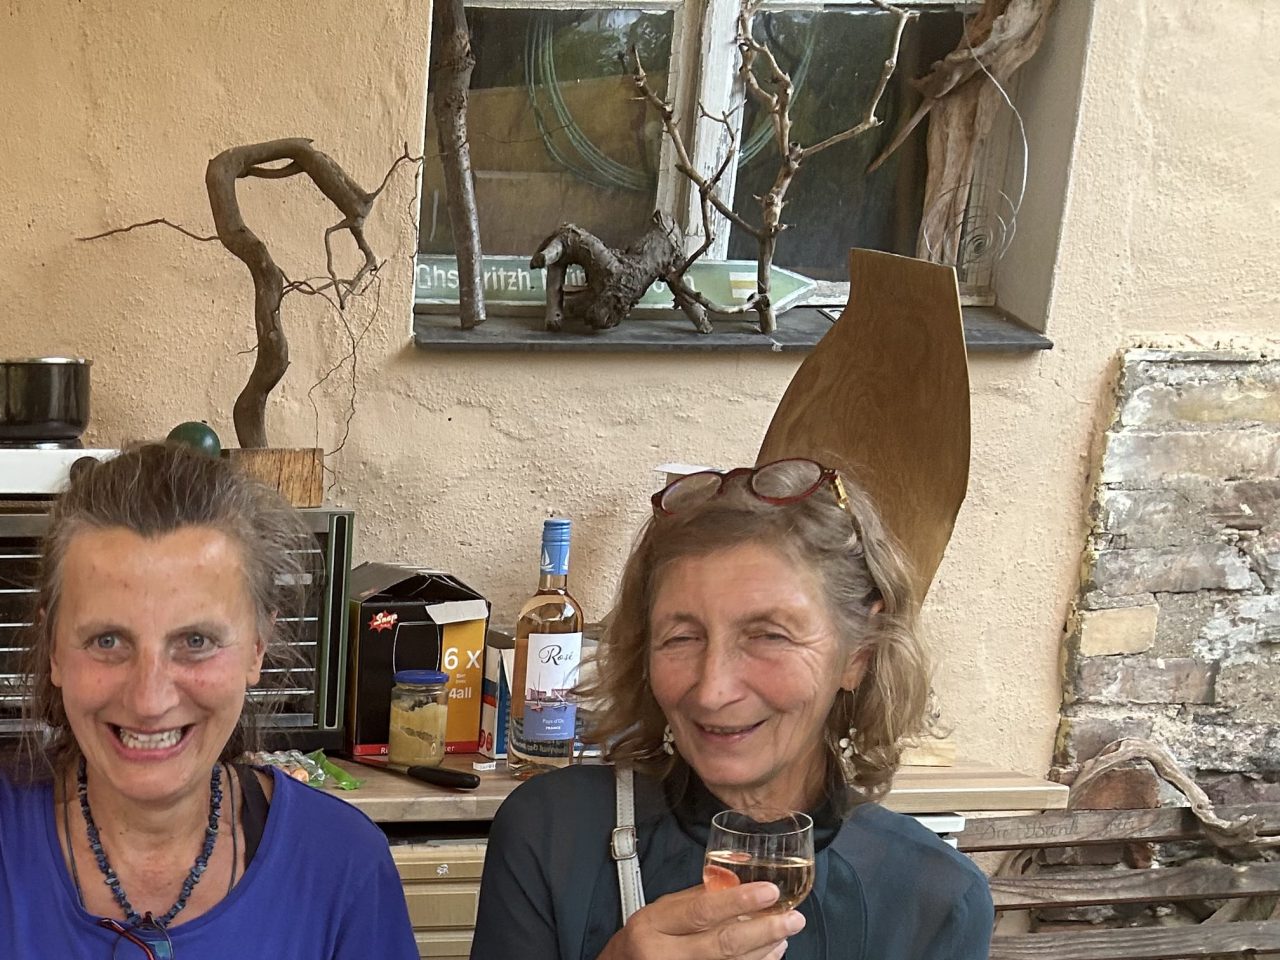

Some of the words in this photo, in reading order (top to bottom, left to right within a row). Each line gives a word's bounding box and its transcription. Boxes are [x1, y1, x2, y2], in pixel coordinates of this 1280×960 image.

[444, 647, 459, 670] 6
[538, 644, 574, 666] Rosé
[448, 686, 472, 699] 4all
